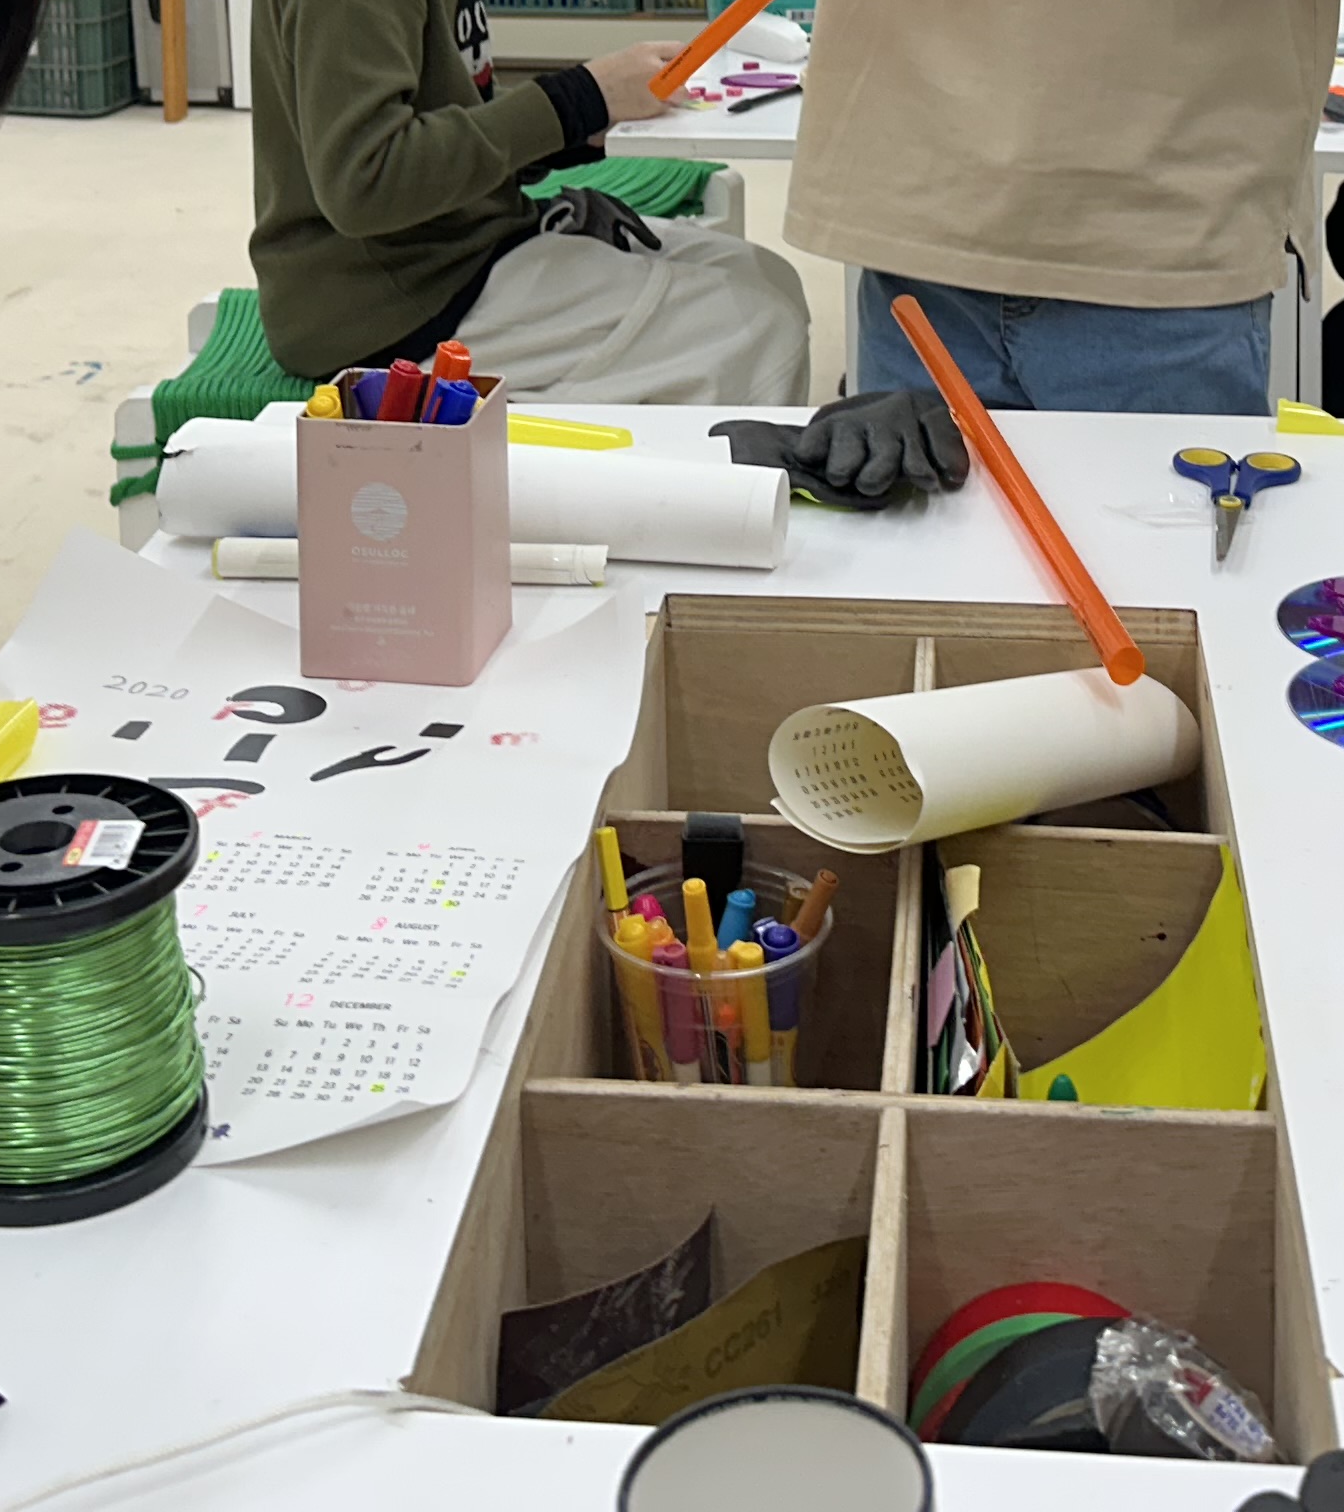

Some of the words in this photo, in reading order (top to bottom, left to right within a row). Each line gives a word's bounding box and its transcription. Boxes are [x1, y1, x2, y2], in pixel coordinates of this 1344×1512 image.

[352, 546, 409, 558] OSULLOC
[102, 675, 189, 700] 2020
[194, 904, 208, 916] 7
[371, 917, 387, 930] 8
[395, 922, 439, 930] AUGUST
[284, 993, 314, 1008] 12
[330, 1000, 392, 1011] DECEMBER
